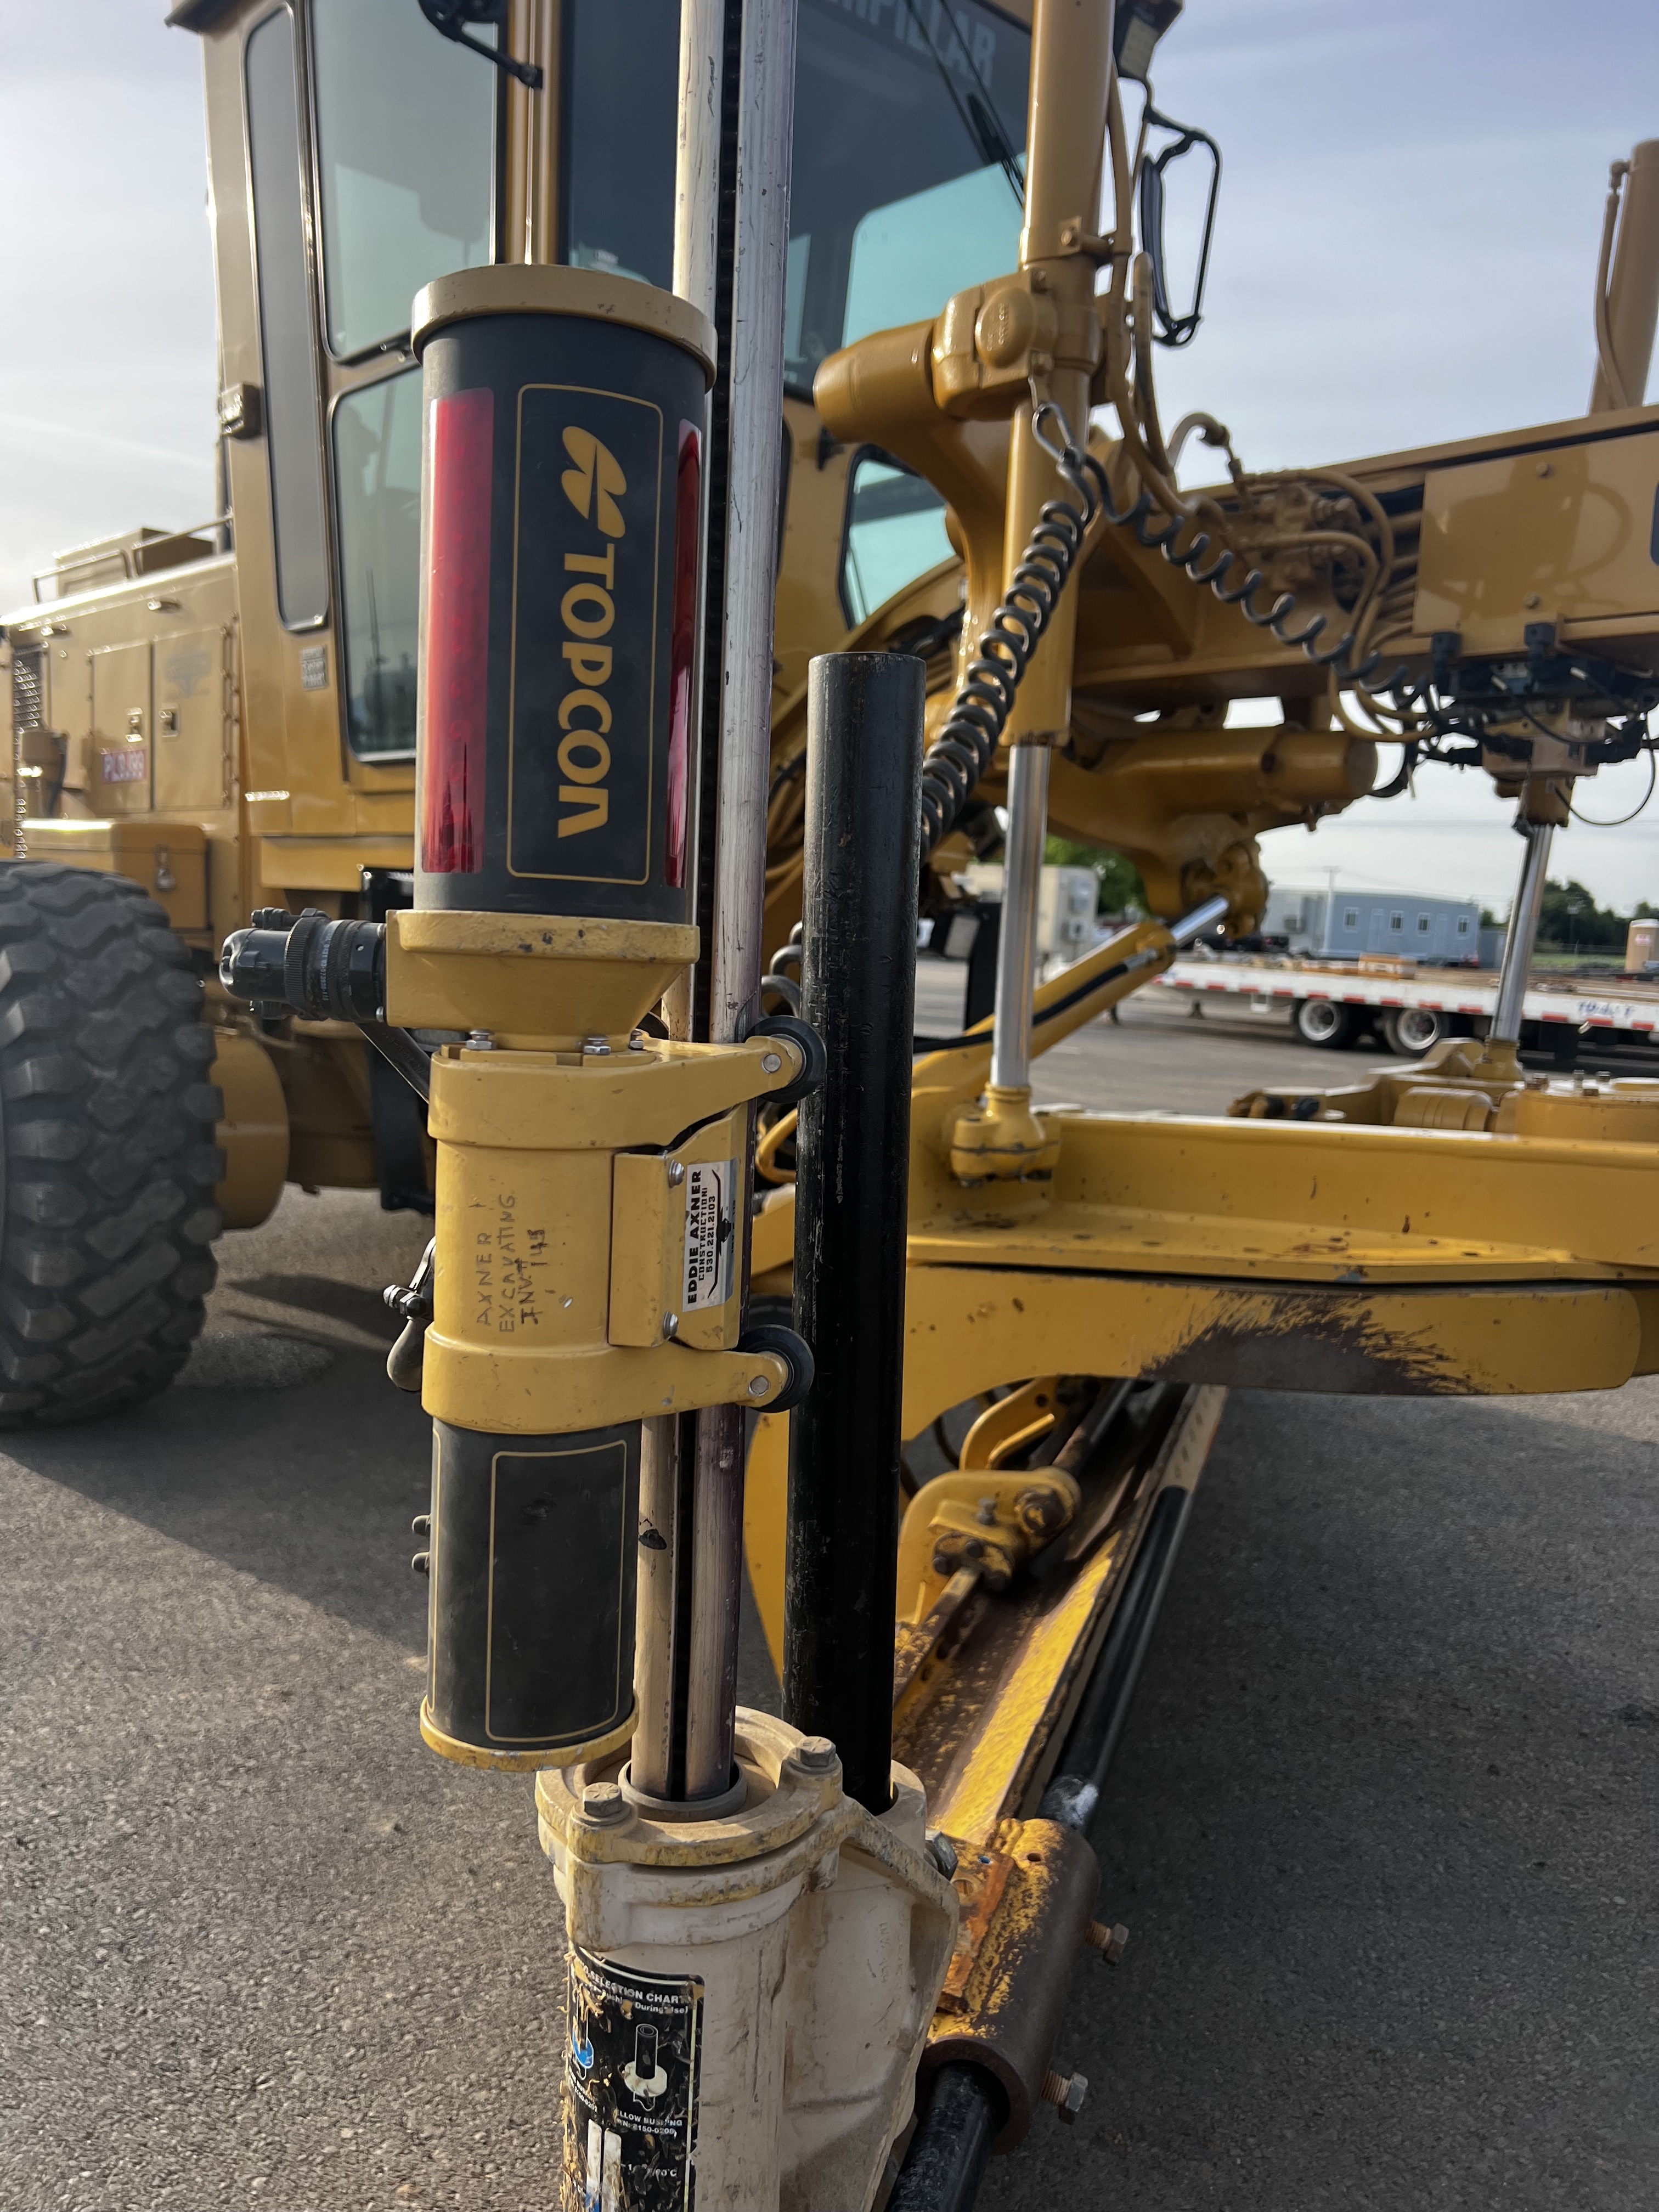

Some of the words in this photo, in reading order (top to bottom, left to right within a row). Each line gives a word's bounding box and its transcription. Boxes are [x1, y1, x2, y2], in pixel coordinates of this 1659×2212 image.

[557, 543, 616, 839] TOPCON
[690, 1170, 702, 1239] AXNER
[706, 1195, 716, 1273] 530.221.2103
[476, 1232, 493, 1326] AXNER
[497, 1193, 516, 1333] EXCAVATING
[688, 1246, 699, 1304] EDDIE
